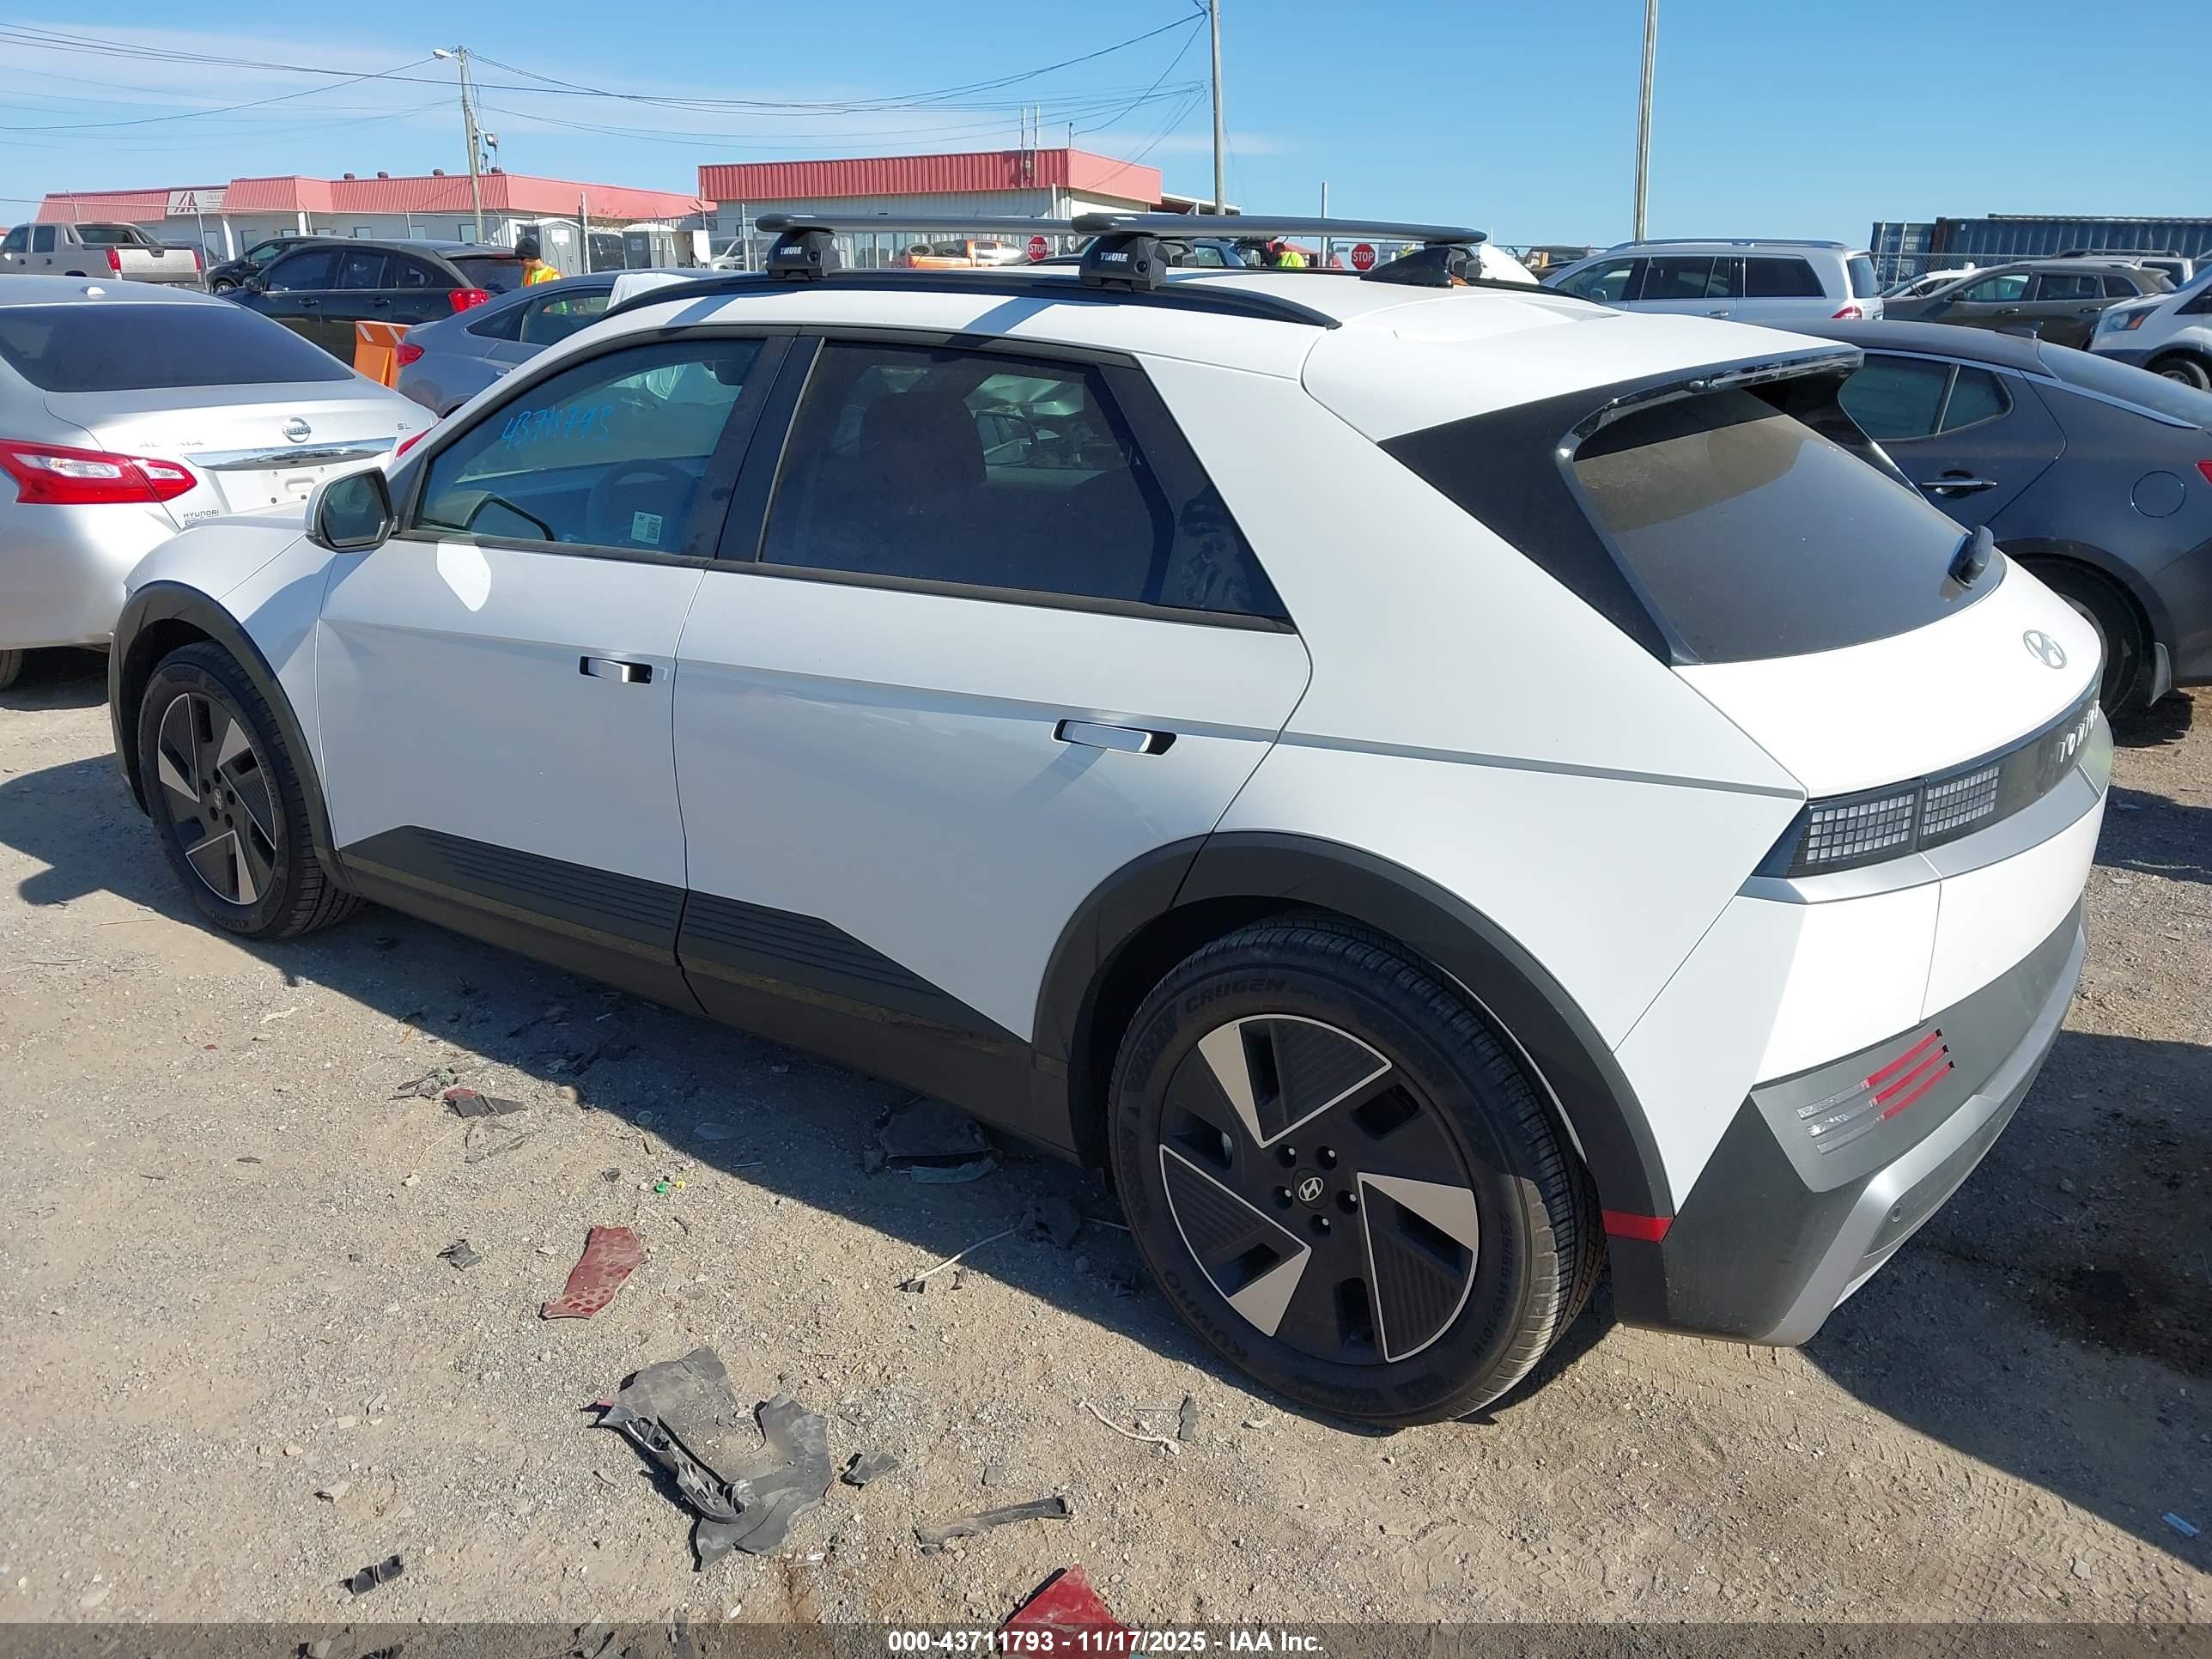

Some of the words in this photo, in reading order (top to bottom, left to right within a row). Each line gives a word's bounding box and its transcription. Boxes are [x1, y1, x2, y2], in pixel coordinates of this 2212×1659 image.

[780, 246, 803, 255] THULE
[1029, 243, 1047, 254] STOP
[1100, 252, 1129, 262] THULE
[1352, 251, 1375, 263] STOP
[183, 508, 220, 519] HYUNDAI
[1185, 978, 1286, 1014] CRUGEN
[1164, 1270, 1249, 1363] KUMHO
